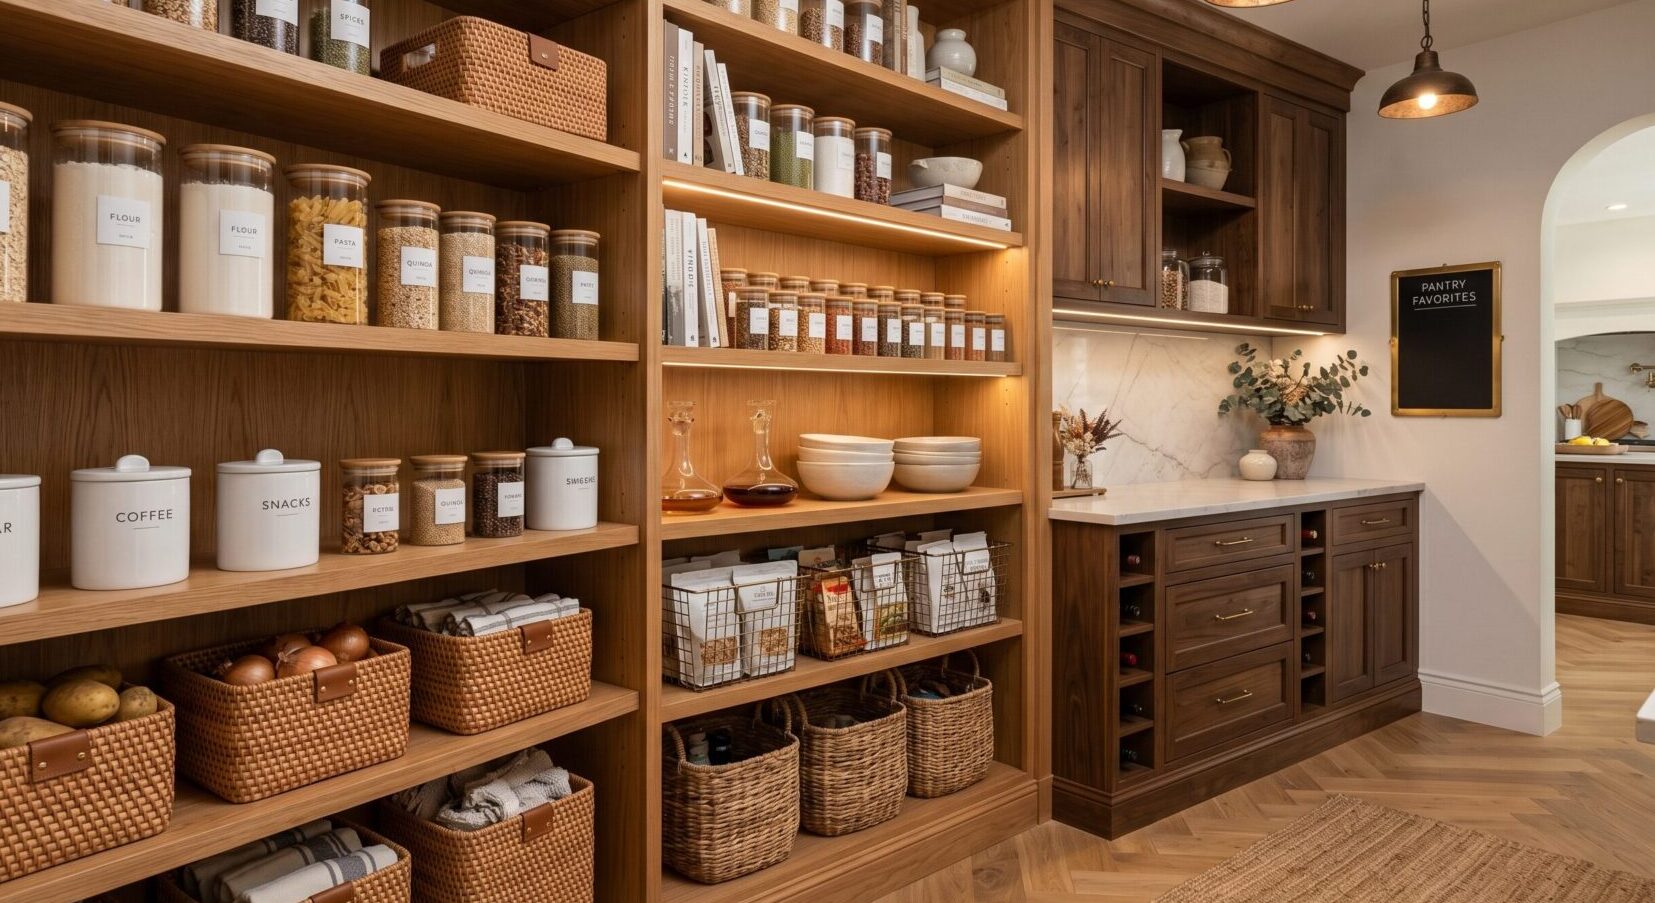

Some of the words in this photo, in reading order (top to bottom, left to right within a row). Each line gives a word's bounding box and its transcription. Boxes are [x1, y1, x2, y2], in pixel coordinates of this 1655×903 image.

[340, 13, 365, 25] SPICES
[110, 213, 141, 224] FLOUR
[231, 225, 258, 235] FLOUR
[334, 238, 356, 247] PASTA
[406, 259, 433, 268] QUINOA
[1421, 279, 1467, 292] PANTRY
[1412, 291, 1477, 306] FAVORITES
[262, 497, 311, 511] SNACKS
[116, 508, 174, 524] COFFEE
[0, 522, 12, 534] R
